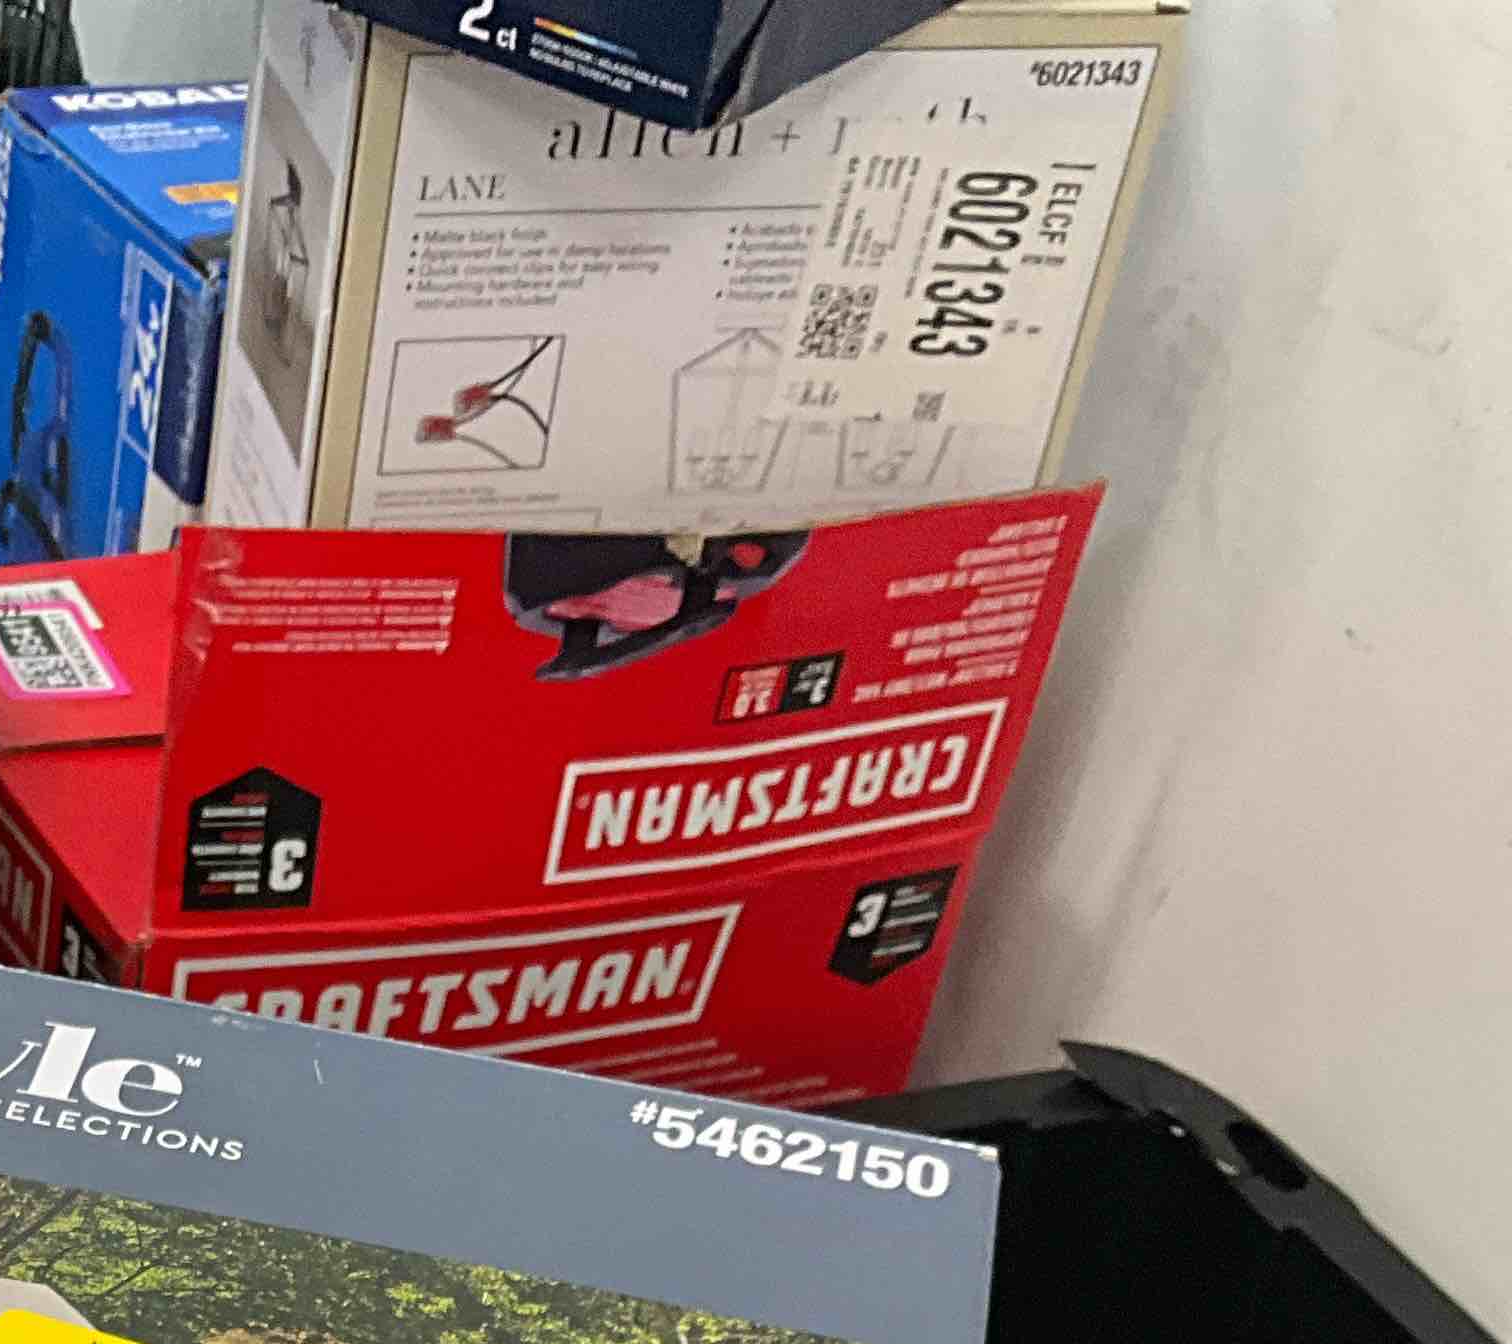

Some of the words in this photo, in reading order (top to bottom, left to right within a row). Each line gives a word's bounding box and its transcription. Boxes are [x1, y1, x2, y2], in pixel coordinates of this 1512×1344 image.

[52, 83, 248, 112] KOBAL
[1030, 61, 1142, 86] #6021343
[418, 175, 506, 202] LANE
[1039, 182, 1082, 246] ELCF
[908, 171, 1039, 358] 6021343
[584, 735, 969, 852] CRAFTSMAN
[268, 838, 308, 892] 3
[847, 891, 886, 939] 3
[630, 1099, 950, 1198] #5462150
